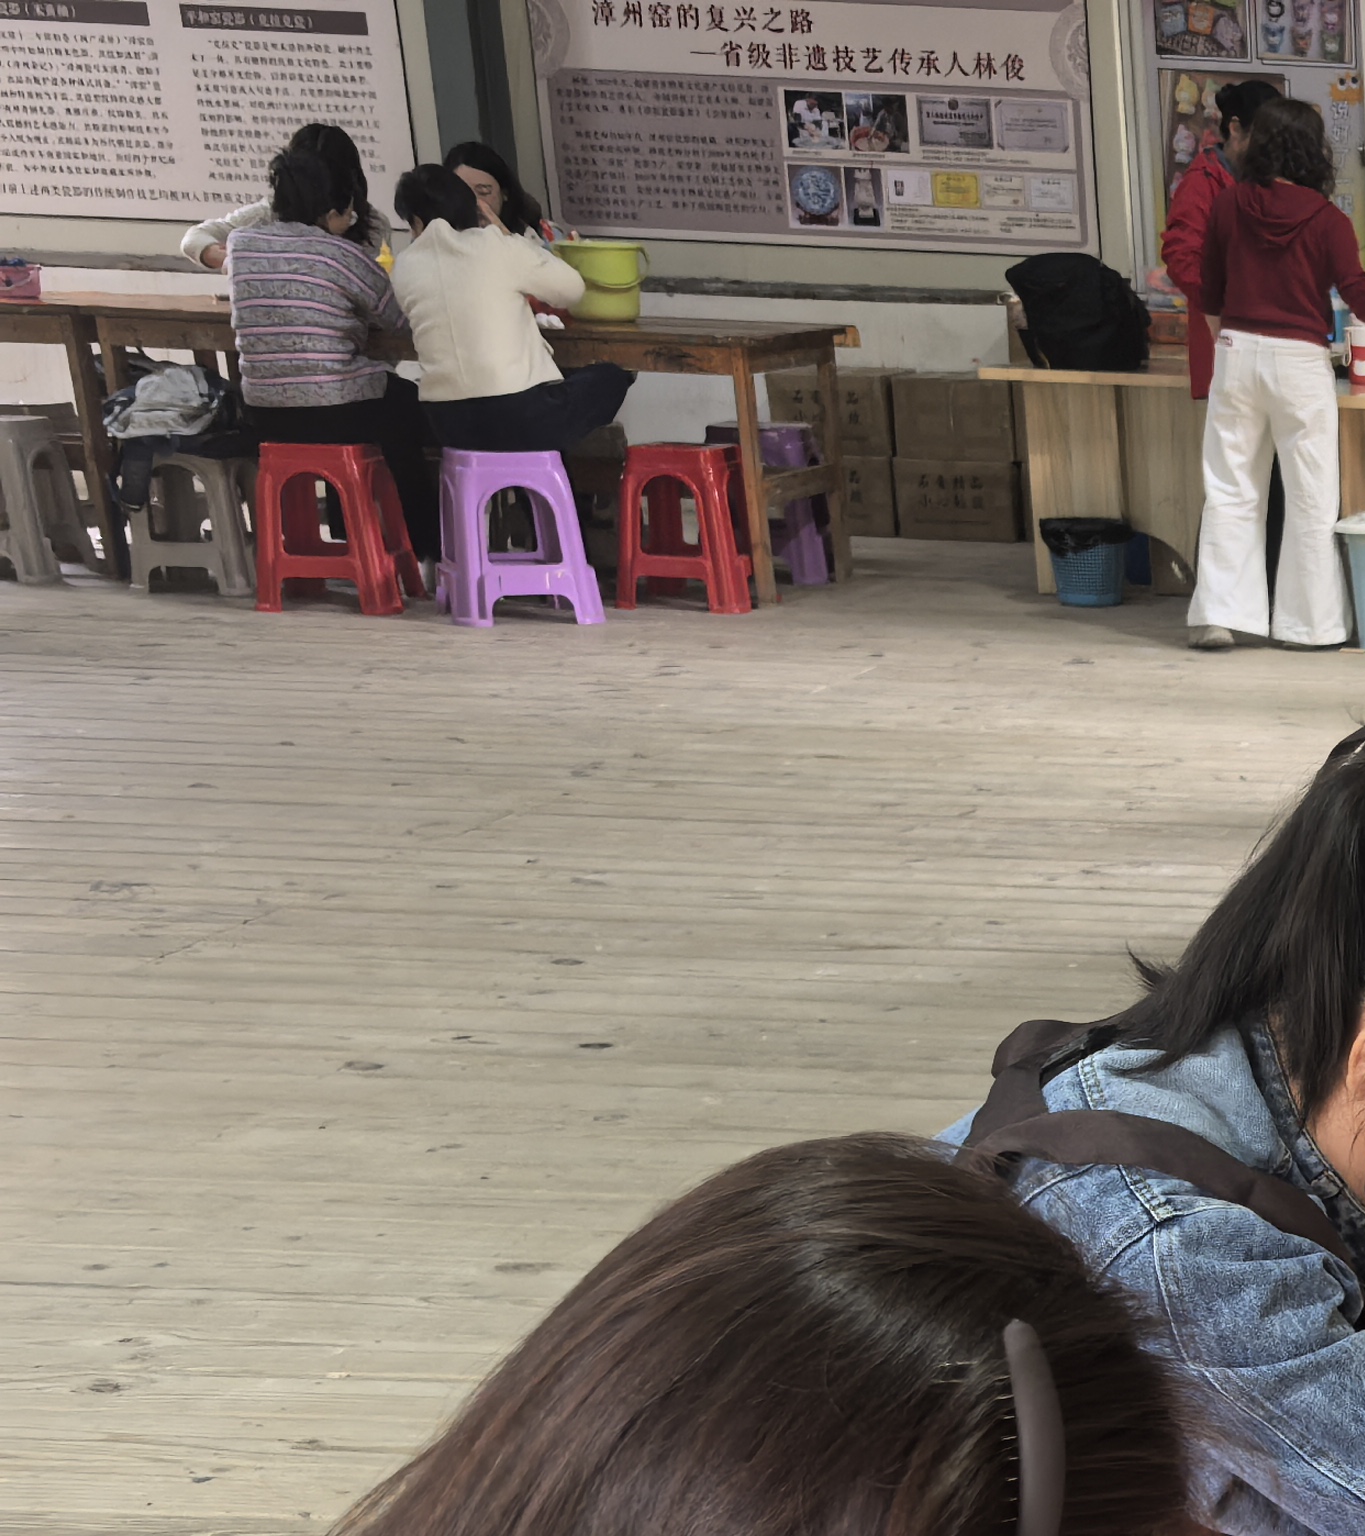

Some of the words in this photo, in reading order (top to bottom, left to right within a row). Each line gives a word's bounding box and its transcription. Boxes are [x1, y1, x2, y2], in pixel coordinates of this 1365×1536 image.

[592, 0, 815, 34] 漳州窑的复兴之路
